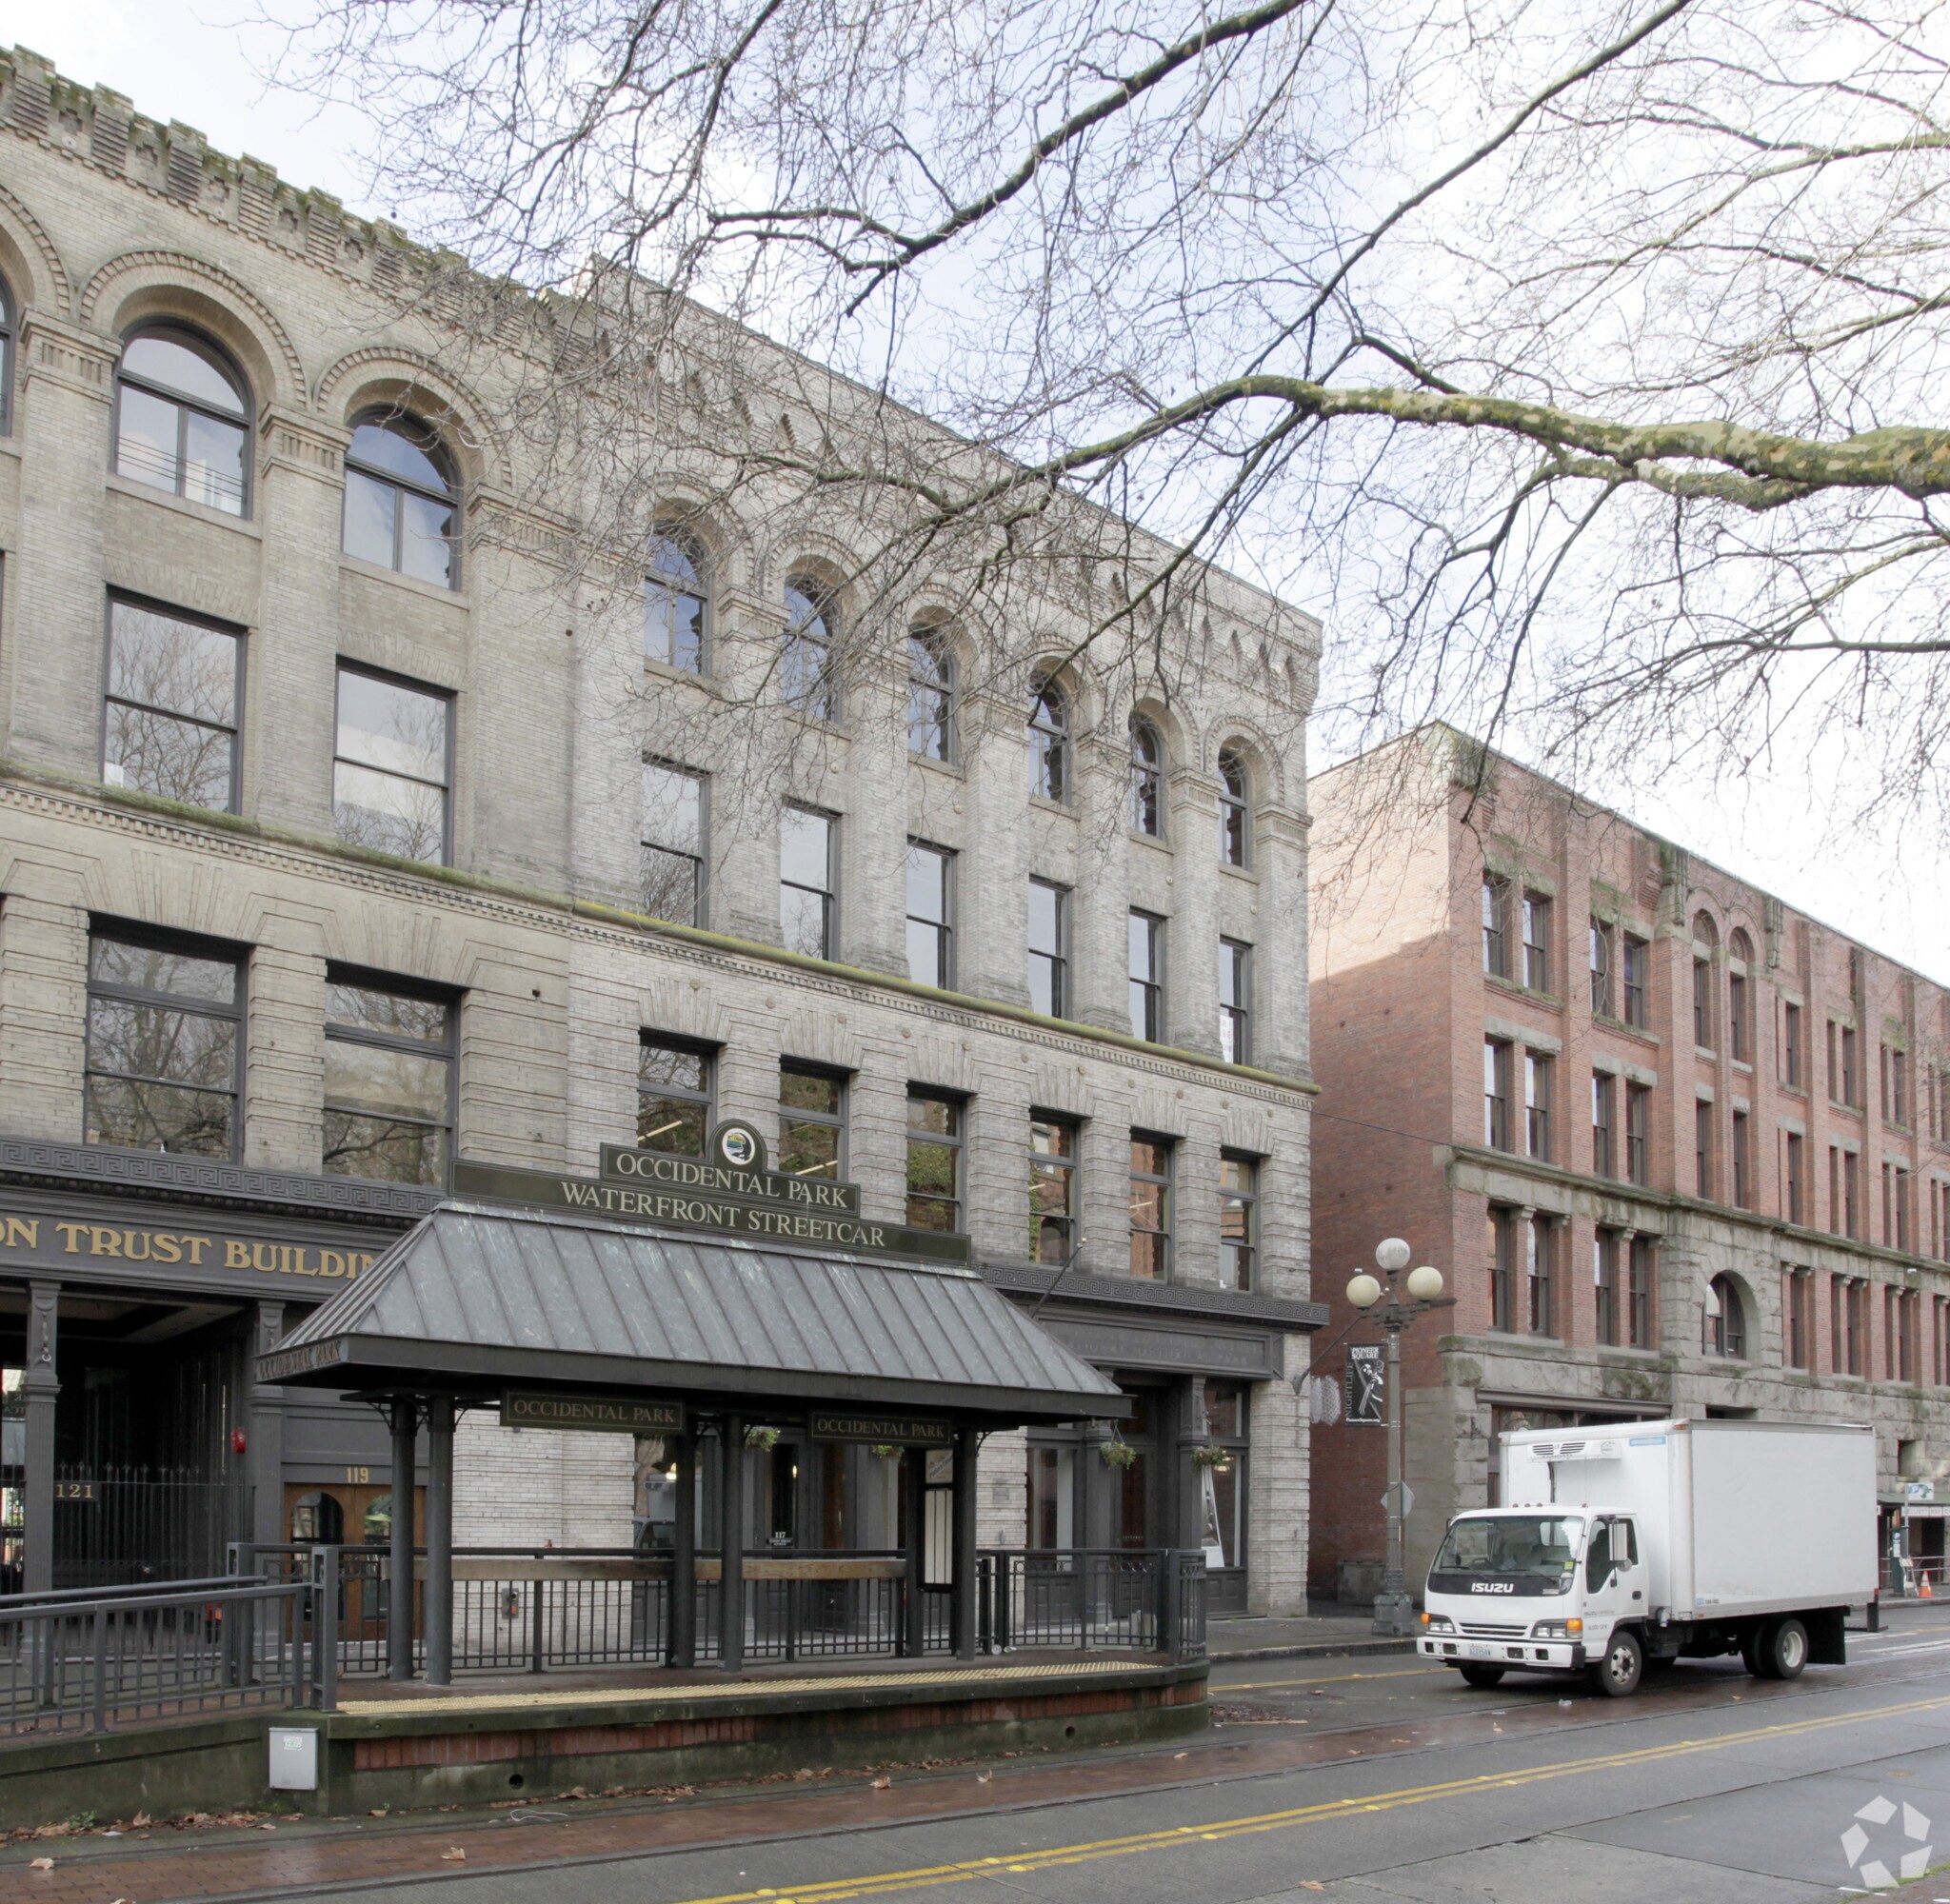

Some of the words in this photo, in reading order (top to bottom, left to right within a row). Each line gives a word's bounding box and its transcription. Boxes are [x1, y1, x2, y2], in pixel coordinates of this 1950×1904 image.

[617, 1153, 780, 1198] OCCIDENTAL
[788, 1180, 847, 1208] PARK
[561, 1181, 740, 1227] WATERFRONT
[748, 1210, 885, 1247] STREETCAR
[0, 1218, 40, 1249] N
[55, 1222, 212, 1264] TRUST
[514, 1400, 627, 1420] OCCIDENTAL
[633, 1407, 674, 1423] PARK
[817, 1418, 907, 1436] OCCIDENTAL
[911, 1423, 945, 1438] PARK
[347, 1467, 368, 1483] 119
[56, 1484, 93, 1498] 121
[1471, 1582, 1514, 1594] ISUZU
